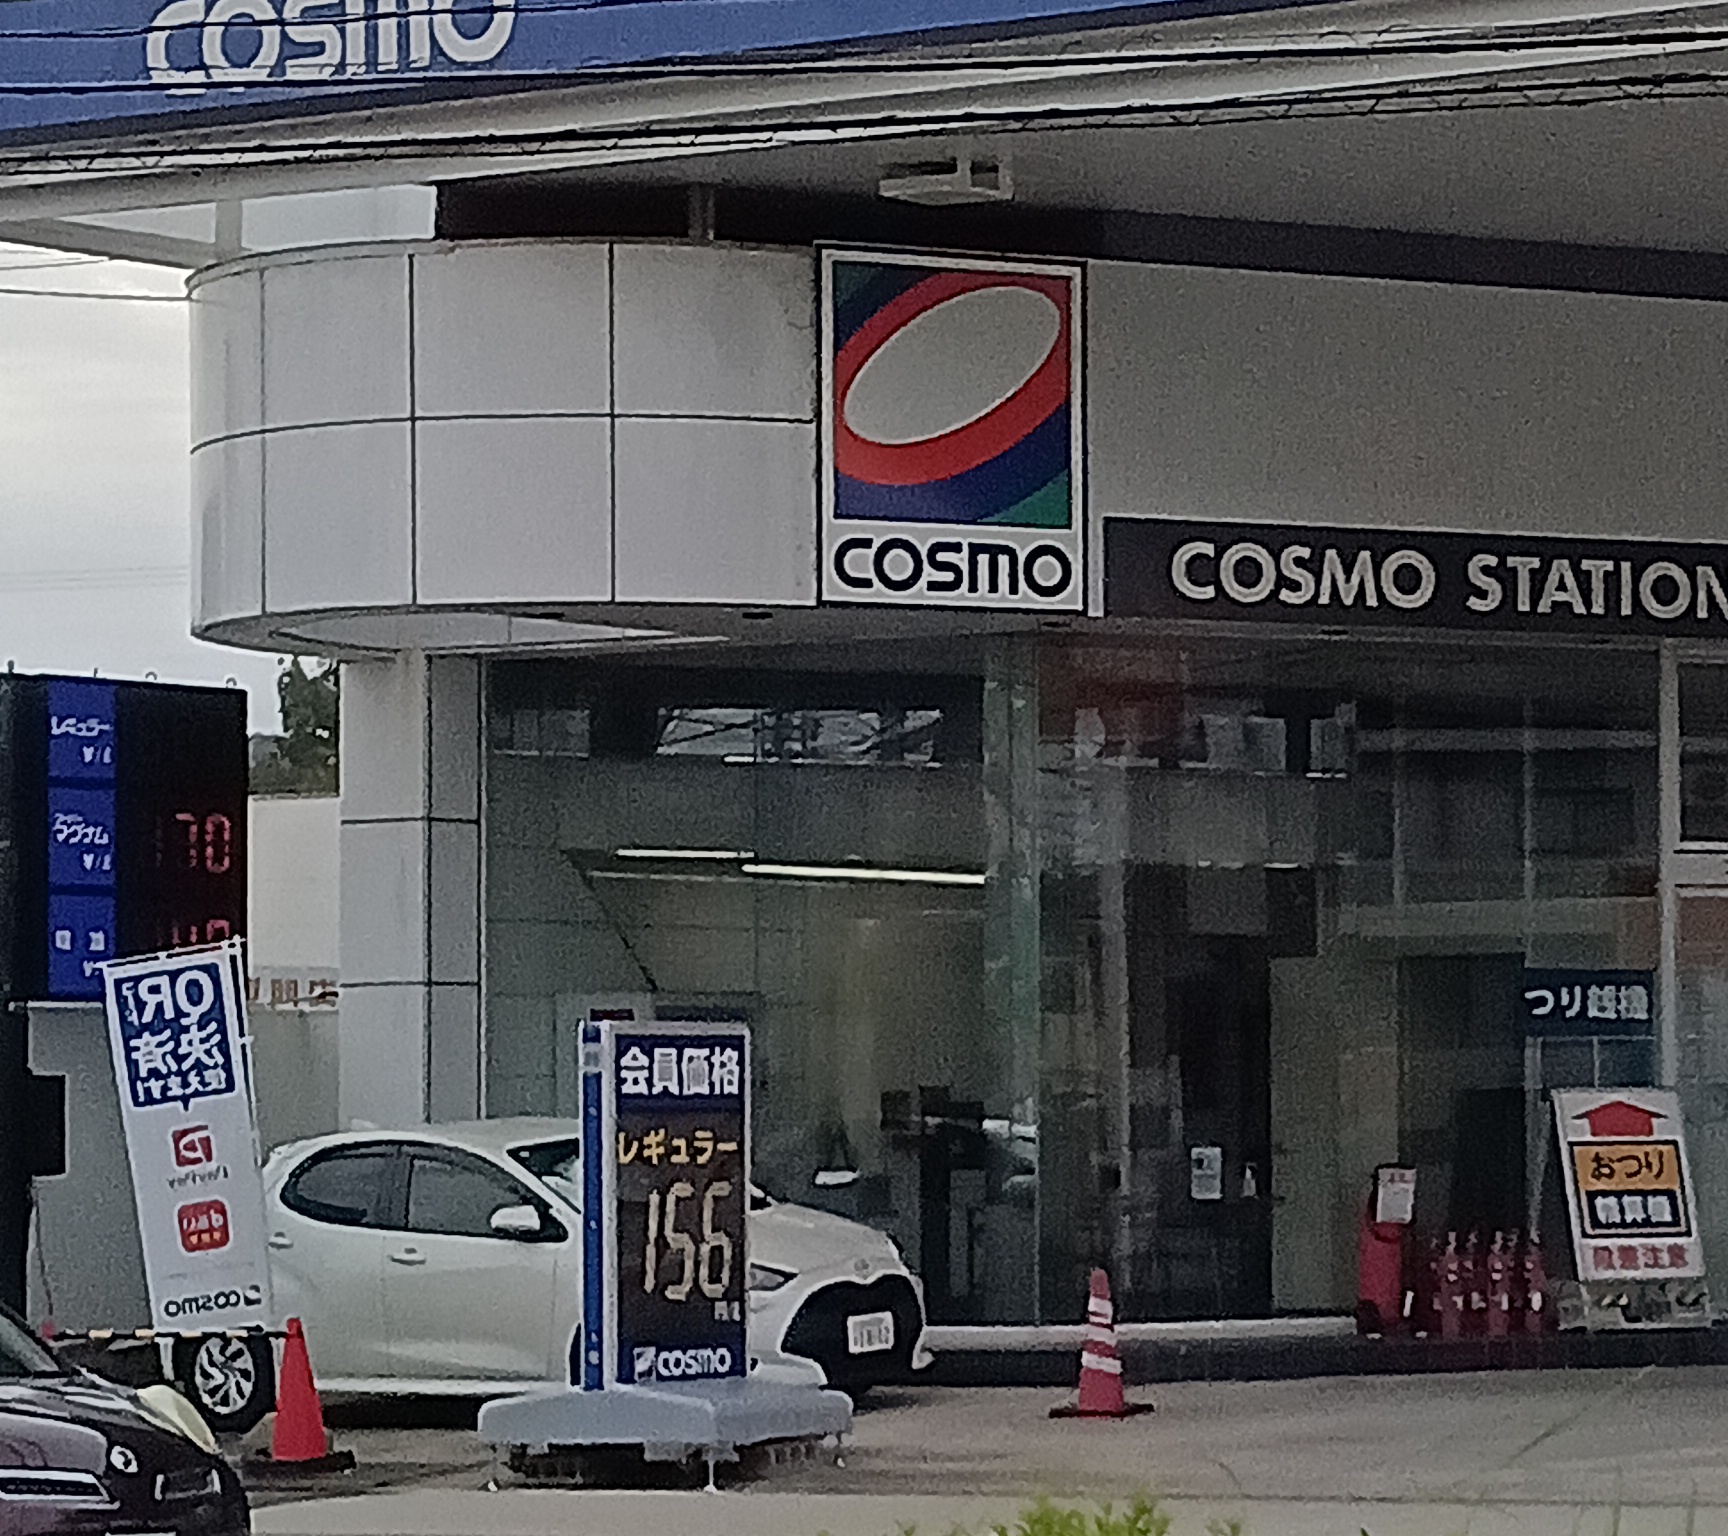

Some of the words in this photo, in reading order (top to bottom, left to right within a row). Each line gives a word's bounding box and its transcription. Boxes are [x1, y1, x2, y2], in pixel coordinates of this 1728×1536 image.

[833, 534, 1073, 598] COSMO
[1170, 540, 1438, 609] COSMO
[619, 1045, 740, 1096] 会員価格
[617, 1127, 740, 1166] レギュラー
[1590, 1148, 1666, 1182] おつり
[643, 1180, 733, 1302] 156
[656, 1346, 732, 1378] COSMO
